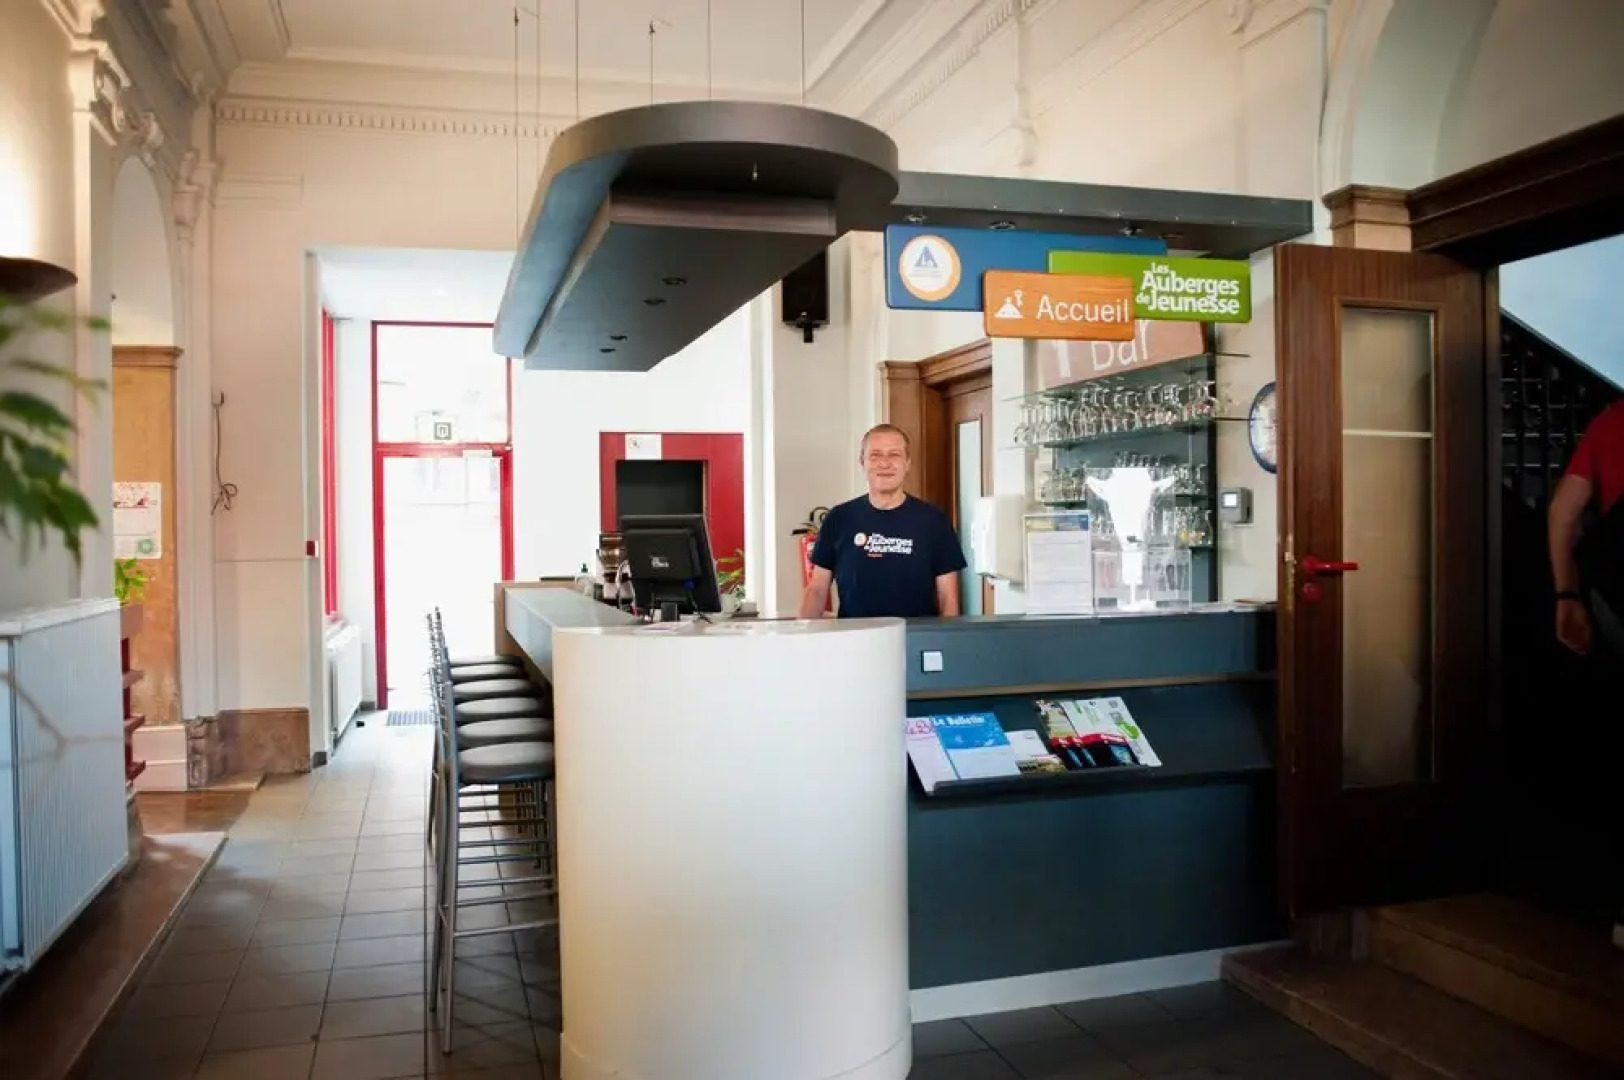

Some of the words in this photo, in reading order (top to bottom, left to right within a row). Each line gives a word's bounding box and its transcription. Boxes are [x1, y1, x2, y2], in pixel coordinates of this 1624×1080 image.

[1151, 262, 1169, 274] Les
[1141, 270, 1240, 297] Auberges
[1036, 295, 1130, 323] Accueil
[1136, 291, 1150, 304] de
[1148, 290, 1240, 315] Jeunesse
